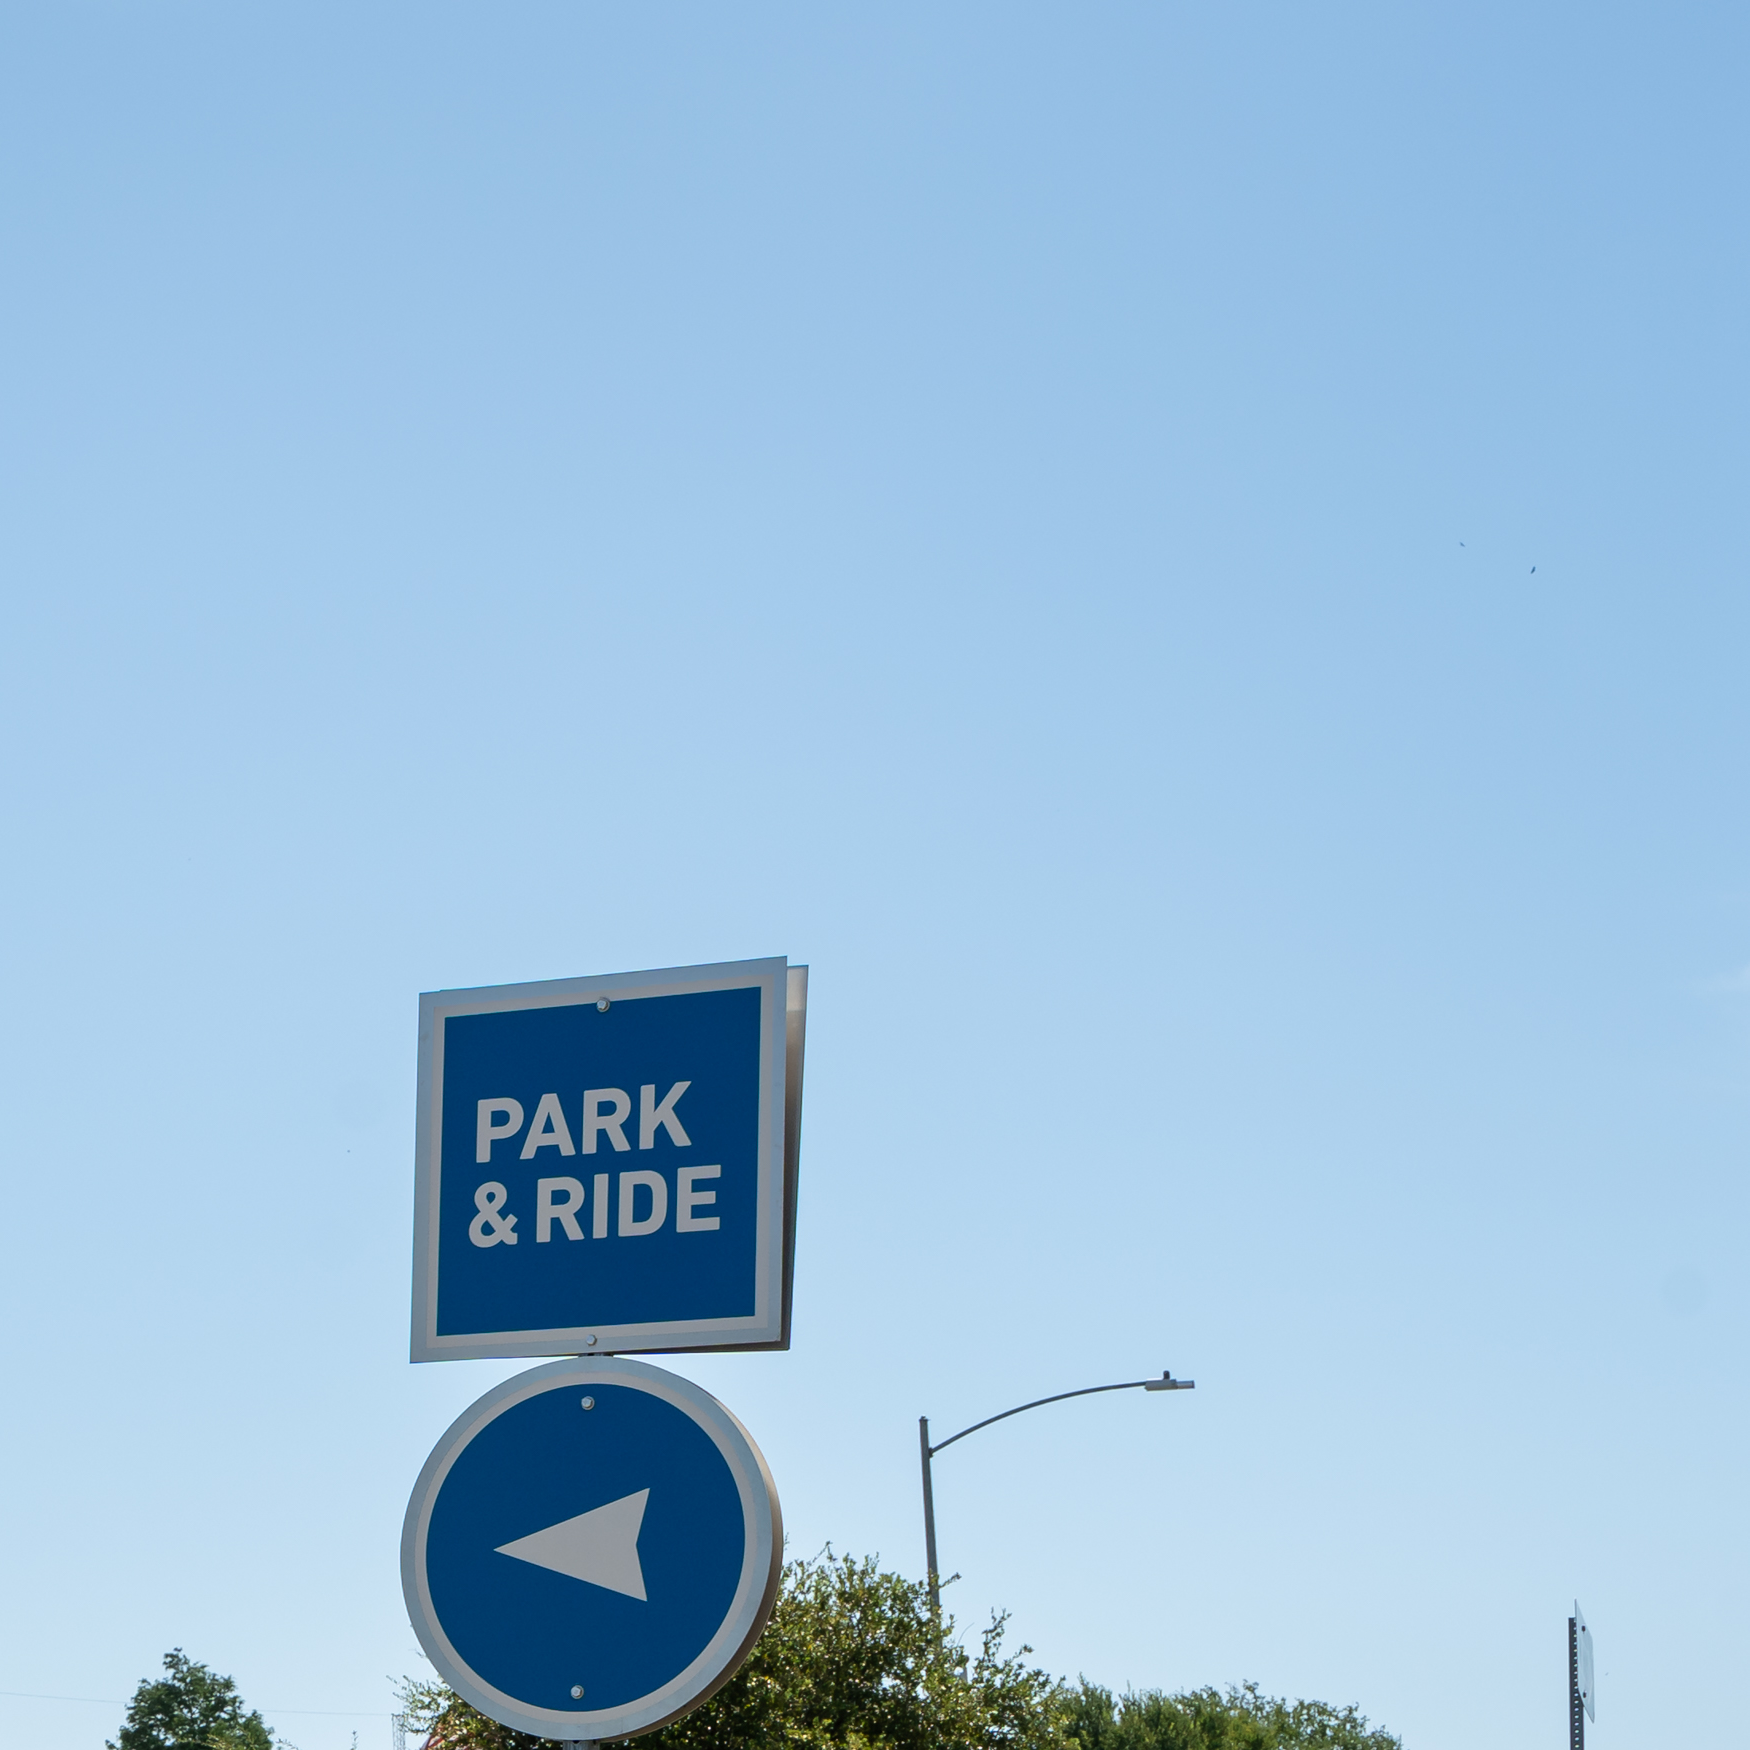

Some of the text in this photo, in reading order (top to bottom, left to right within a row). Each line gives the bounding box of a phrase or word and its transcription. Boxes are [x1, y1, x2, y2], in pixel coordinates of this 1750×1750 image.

[476, 1081, 692, 1163] PARK
[468, 1164, 722, 1248] & RIDE
